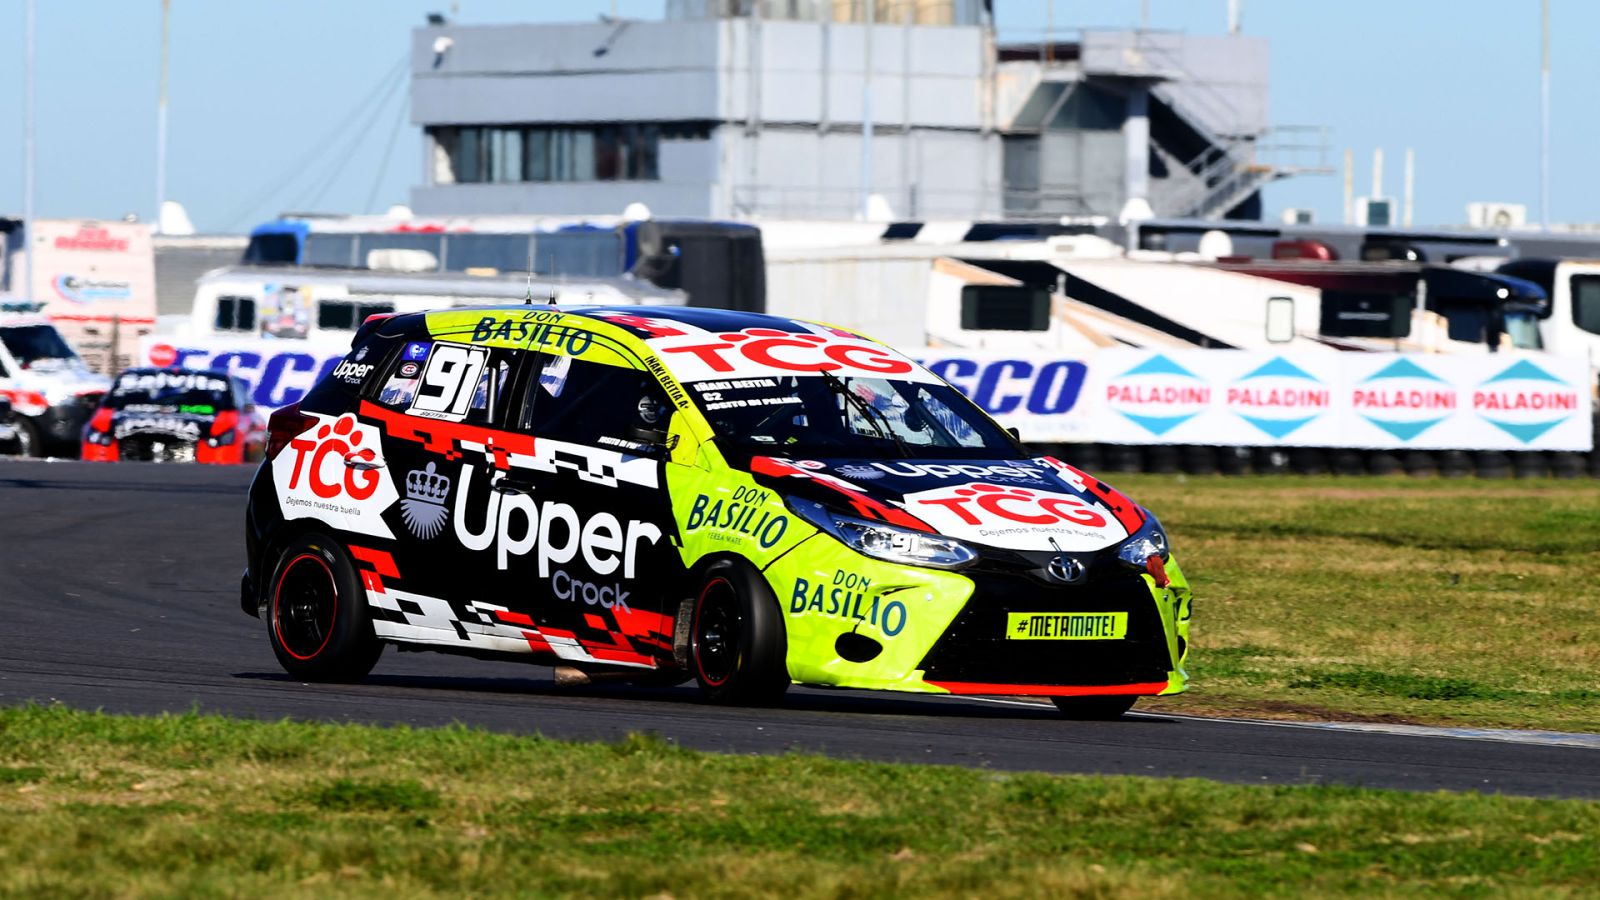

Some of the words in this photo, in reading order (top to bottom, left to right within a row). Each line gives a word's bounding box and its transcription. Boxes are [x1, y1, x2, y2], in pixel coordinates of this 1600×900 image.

[523, 312, 565, 324] DON
[471, 317, 592, 356] BASILIO
[661, 338, 913, 374] TCG
[172, 350, 343, 407] SC
[333, 359, 375, 379] Upper
[345, 376, 362, 385] Crock
[414, 346, 485, 415] 91
[660, 375, 684, 402] BEITIA
[731, 379, 777, 389] BEITIA
[917, 358, 1088, 415] SCO
[702, 392, 723, 402] C2
[706, 400, 748, 411] JOSITO
[747, 399, 762, 407] DI
[1106, 385, 1211, 405] PALADINI
[1226, 388, 1331, 407] PALADINI
[1353, 390, 1457, 410] PALADINI
[1473, 391, 1578, 410] PALADINI
[288, 438, 380, 501] TCG
[870, 462, 1044, 479] Upper
[285, 496, 312, 507] Dejemos
[313, 501, 339, 513] nuestra
[732, 485, 771, 507] DON
[453, 463, 662, 578] Upper
[686, 493, 788, 549] BASILIO
[918, 493, 1107, 528] TCG
[892, 533, 920, 553] 91
[979, 527, 1029, 537] Dejemos
[1031, 527, 1073, 536] nuestra
[552, 570, 632, 614] Crock
[833, 569, 871, 593] DON
[790, 577, 907, 637] BASILIO
[1016, 614, 1115, 638] #METAMATE!
